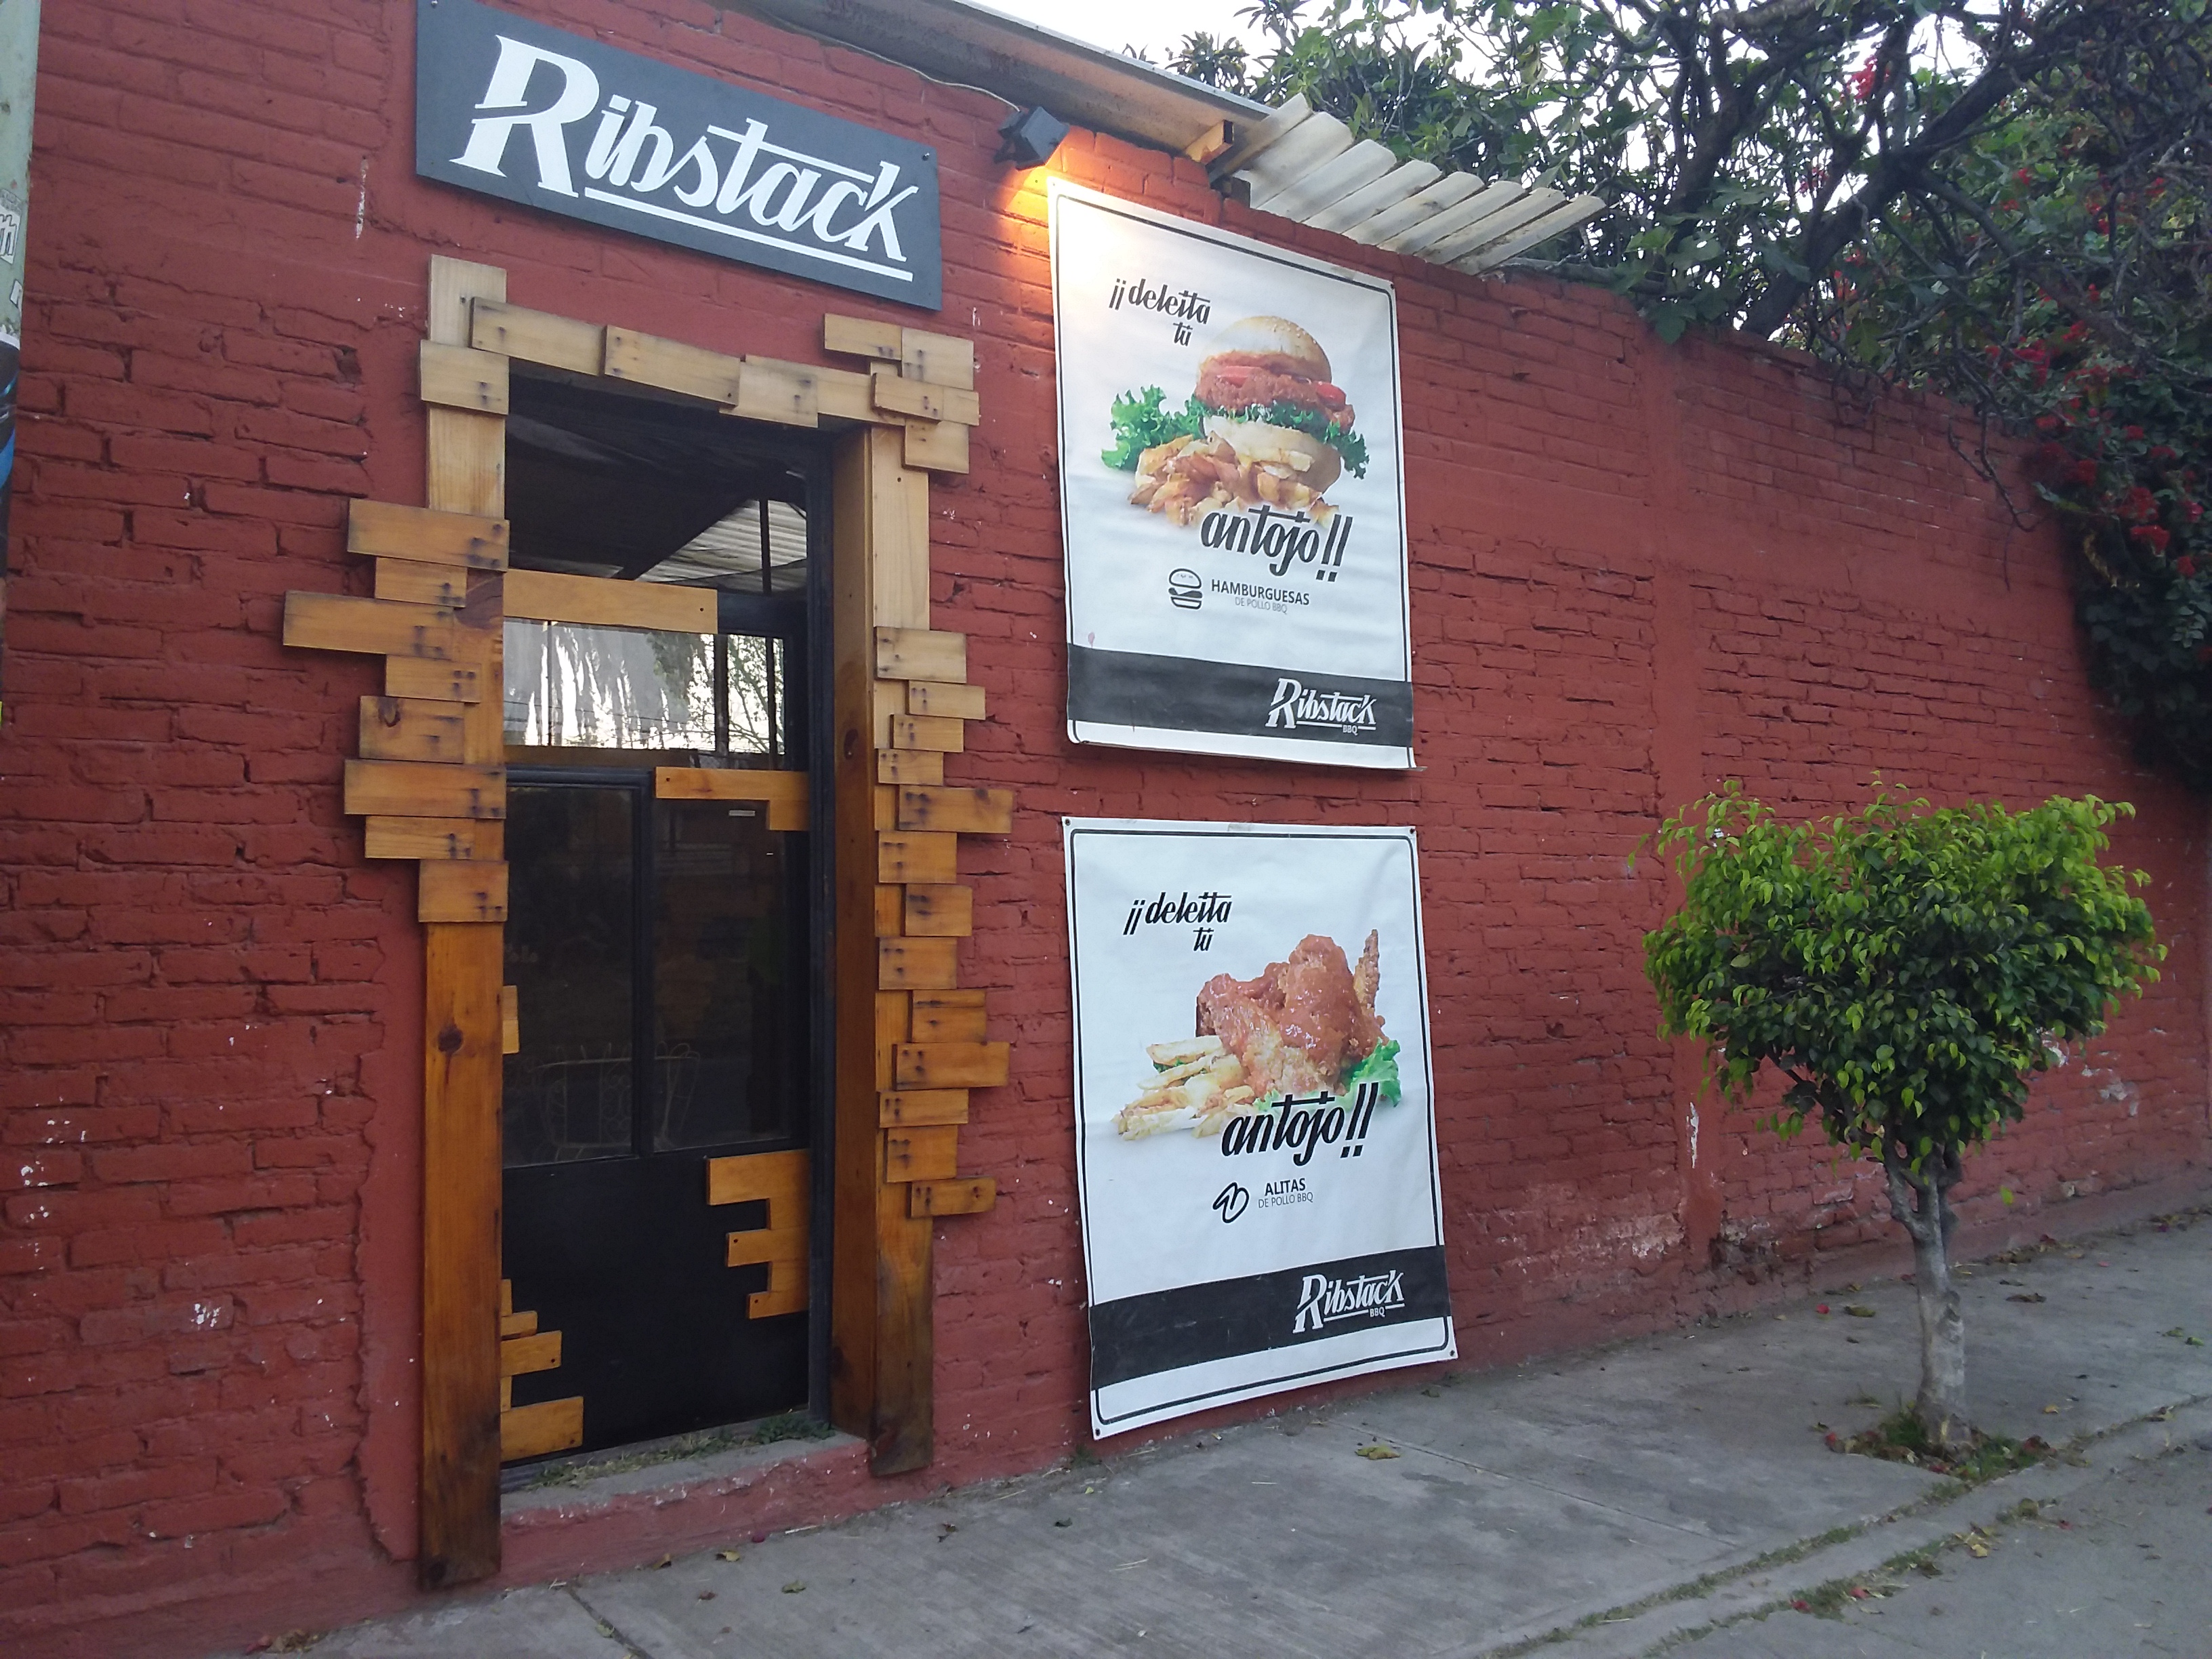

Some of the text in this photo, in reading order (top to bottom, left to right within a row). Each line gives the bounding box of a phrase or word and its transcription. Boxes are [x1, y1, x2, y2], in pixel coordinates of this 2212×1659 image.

[450, 34, 919, 263] Ribstack
[1200, 504, 1353, 582] antojo!!
[1211, 579, 1309, 605] HAMBURGUESAS
[1235, 597, 1288, 615] DE POLLO BBQ
[1265, 678, 1377, 729] Ribstack
[1342, 724, 1359, 736] BBQ
[1222, 1082, 1378, 1167] antojo!!
[1258, 1191, 1313, 1208] DE POLLO BBQ
[1264, 1177, 1306, 1196] ALITAS
[1292, 1269, 1405, 1334] Ribstack
[1370, 1307, 1386, 1318] BBQ
